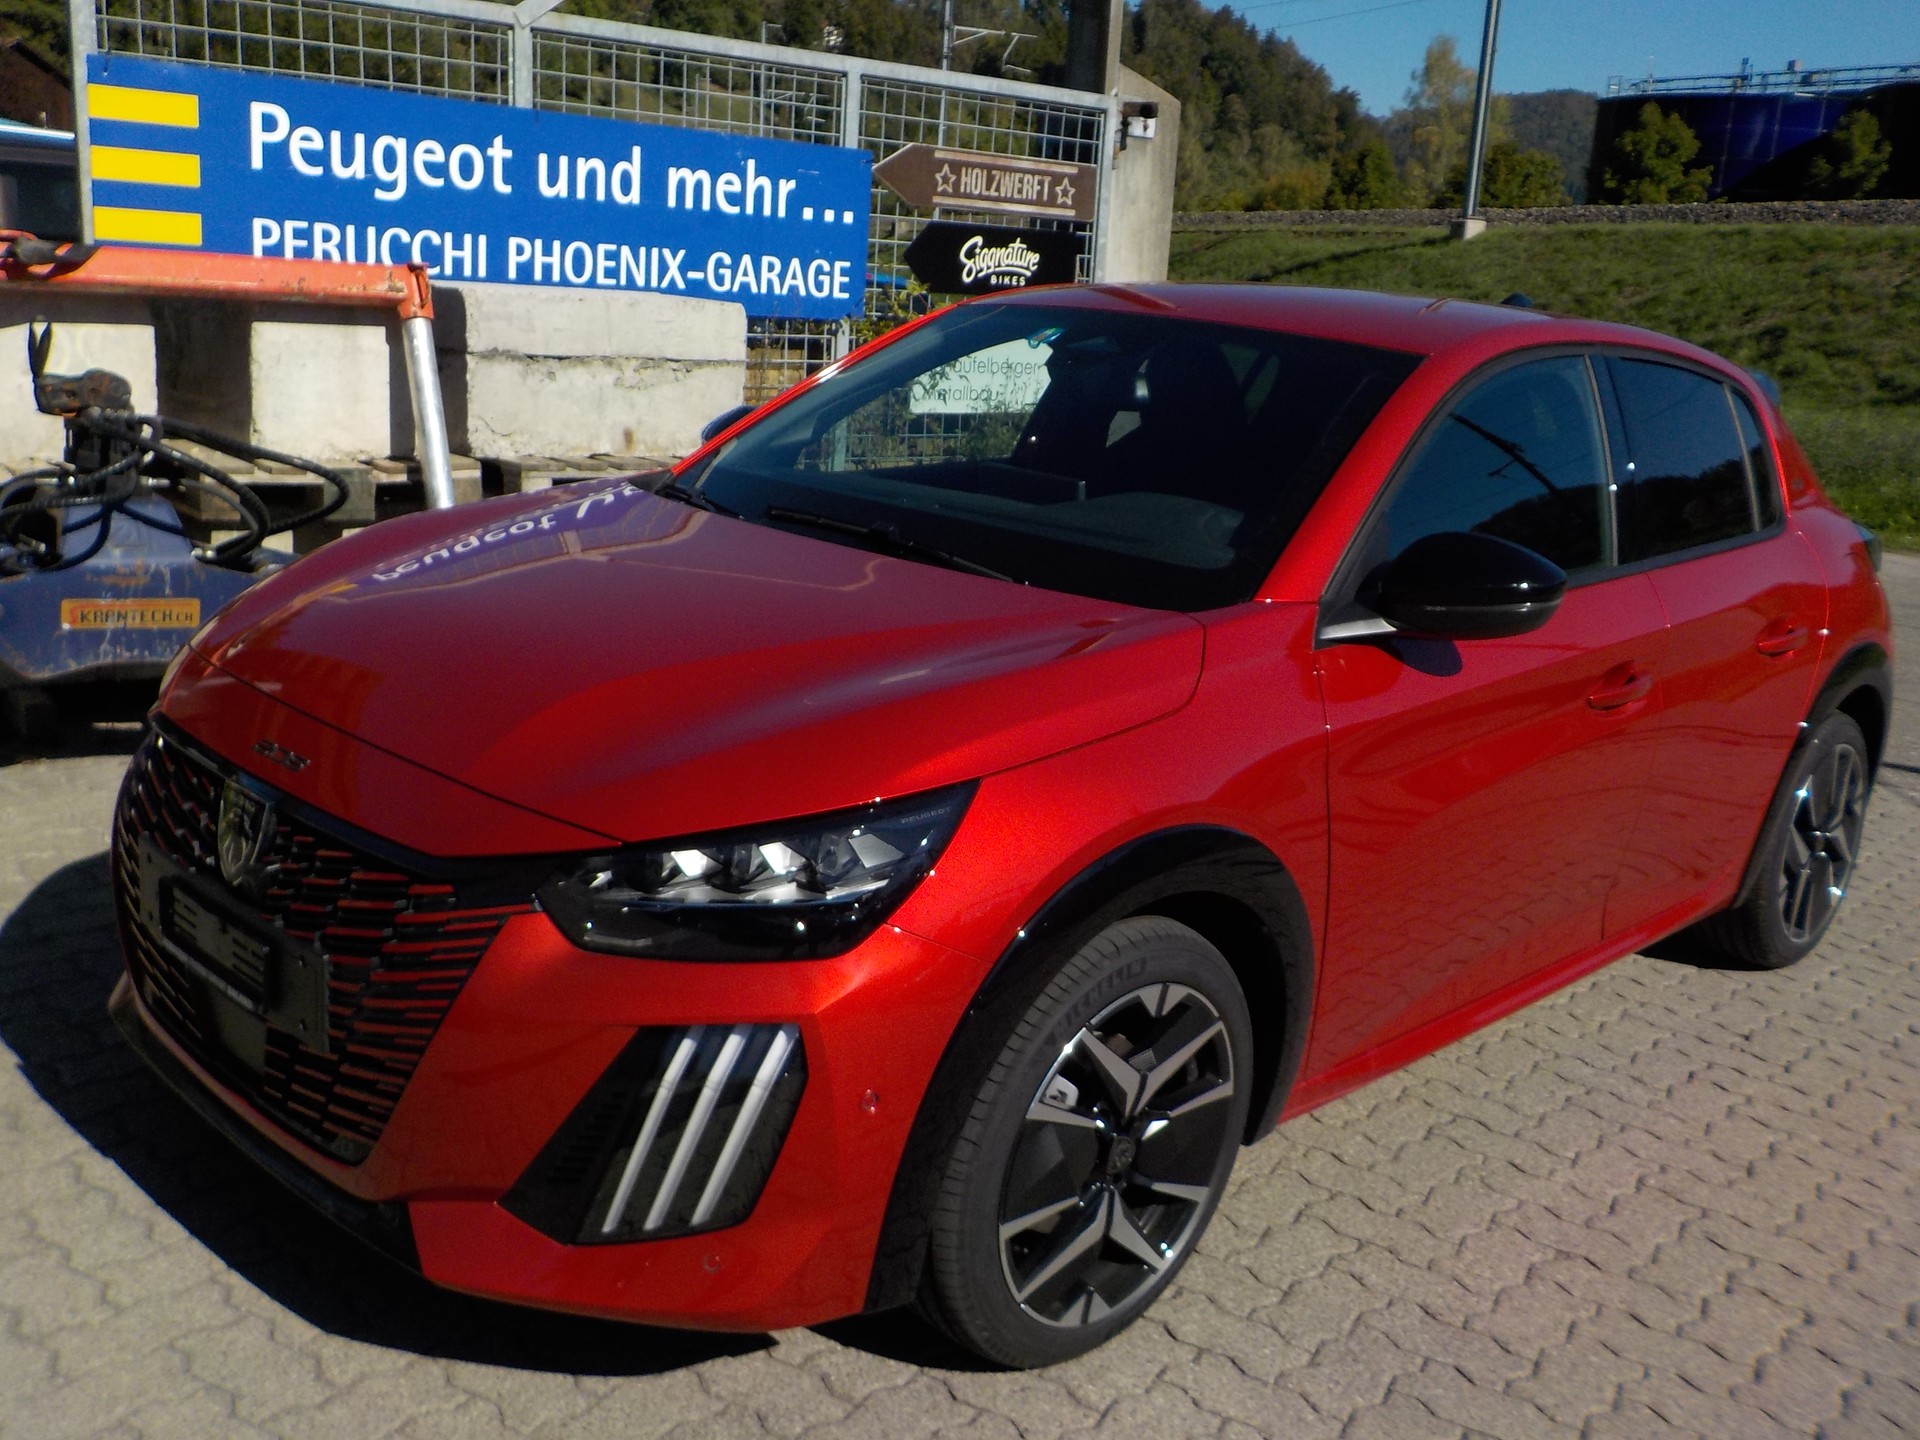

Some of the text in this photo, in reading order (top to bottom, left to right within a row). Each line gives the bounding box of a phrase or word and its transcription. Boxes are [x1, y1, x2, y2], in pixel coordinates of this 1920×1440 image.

[250, 101, 855, 224] Peugeot und mehr...
[960, 166, 1052, 202] HOLZWERFT
[252, 217, 852, 299] PERUCCHI PHOENIX-GARAGE
[990, 275, 1026, 286] BIKES
[901, 807, 951, 824] PEUGEOT
